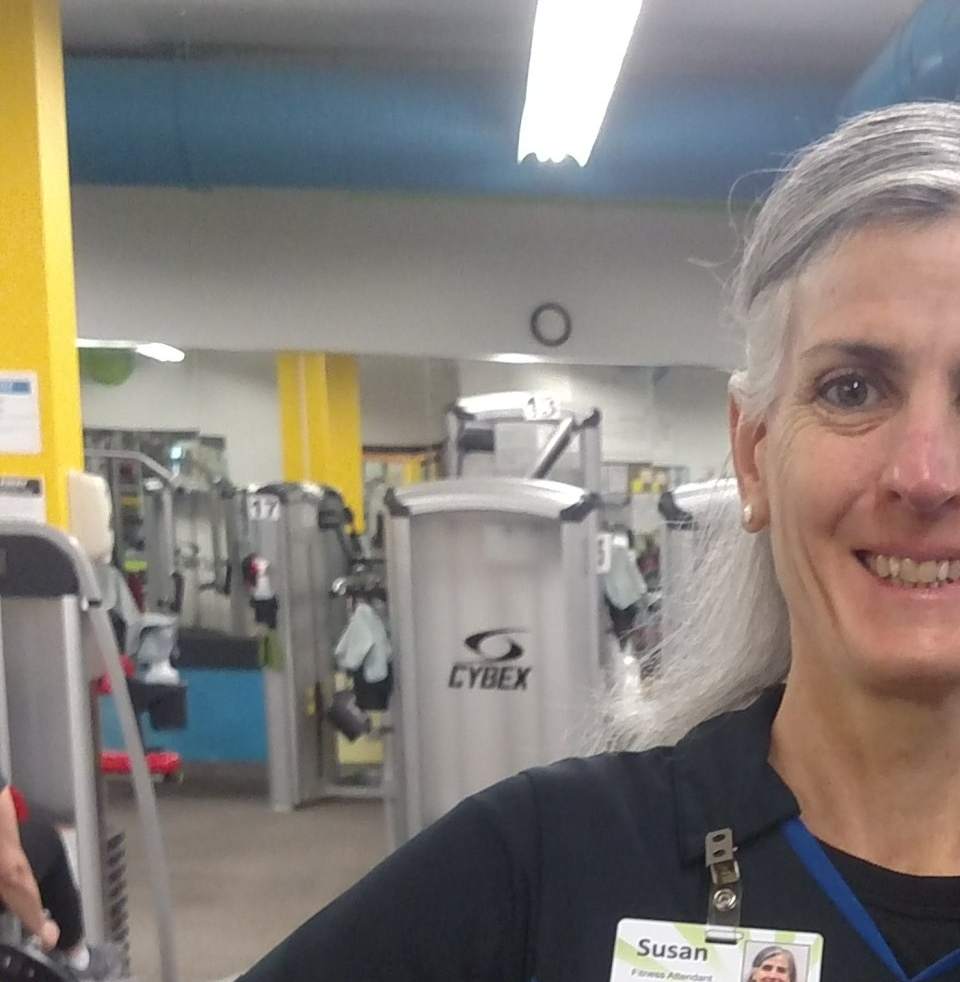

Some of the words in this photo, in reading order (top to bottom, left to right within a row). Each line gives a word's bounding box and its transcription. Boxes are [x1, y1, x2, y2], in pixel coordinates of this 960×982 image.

[252, 499, 279, 519] 17
[448, 663, 532, 691] CYBEX
[636, 938, 709, 963] Susan
[631, 968, 666, 979] Fitness
[667, 971, 713, 982] Attendant
